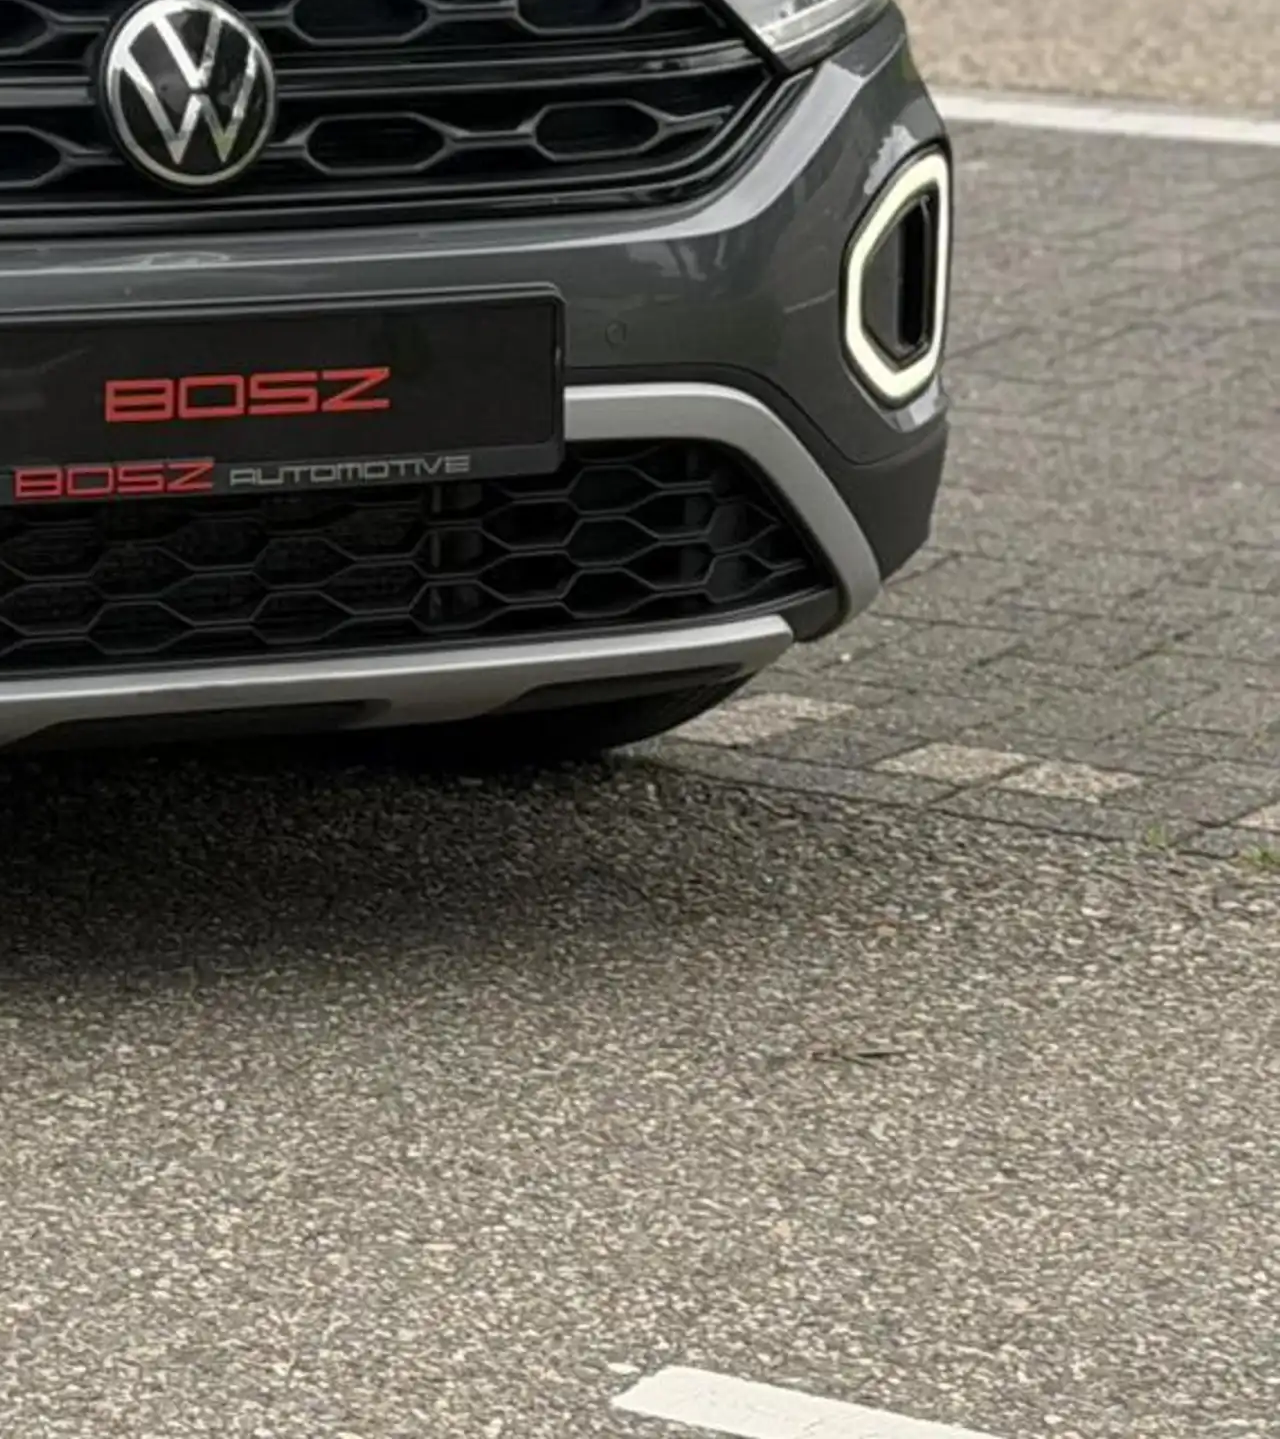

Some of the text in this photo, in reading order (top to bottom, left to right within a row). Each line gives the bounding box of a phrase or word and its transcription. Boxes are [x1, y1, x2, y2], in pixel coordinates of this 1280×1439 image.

[104, 366, 390, 422] BOSZ
[13, 455, 471, 498] BOSZ AUTOMOTIVE
